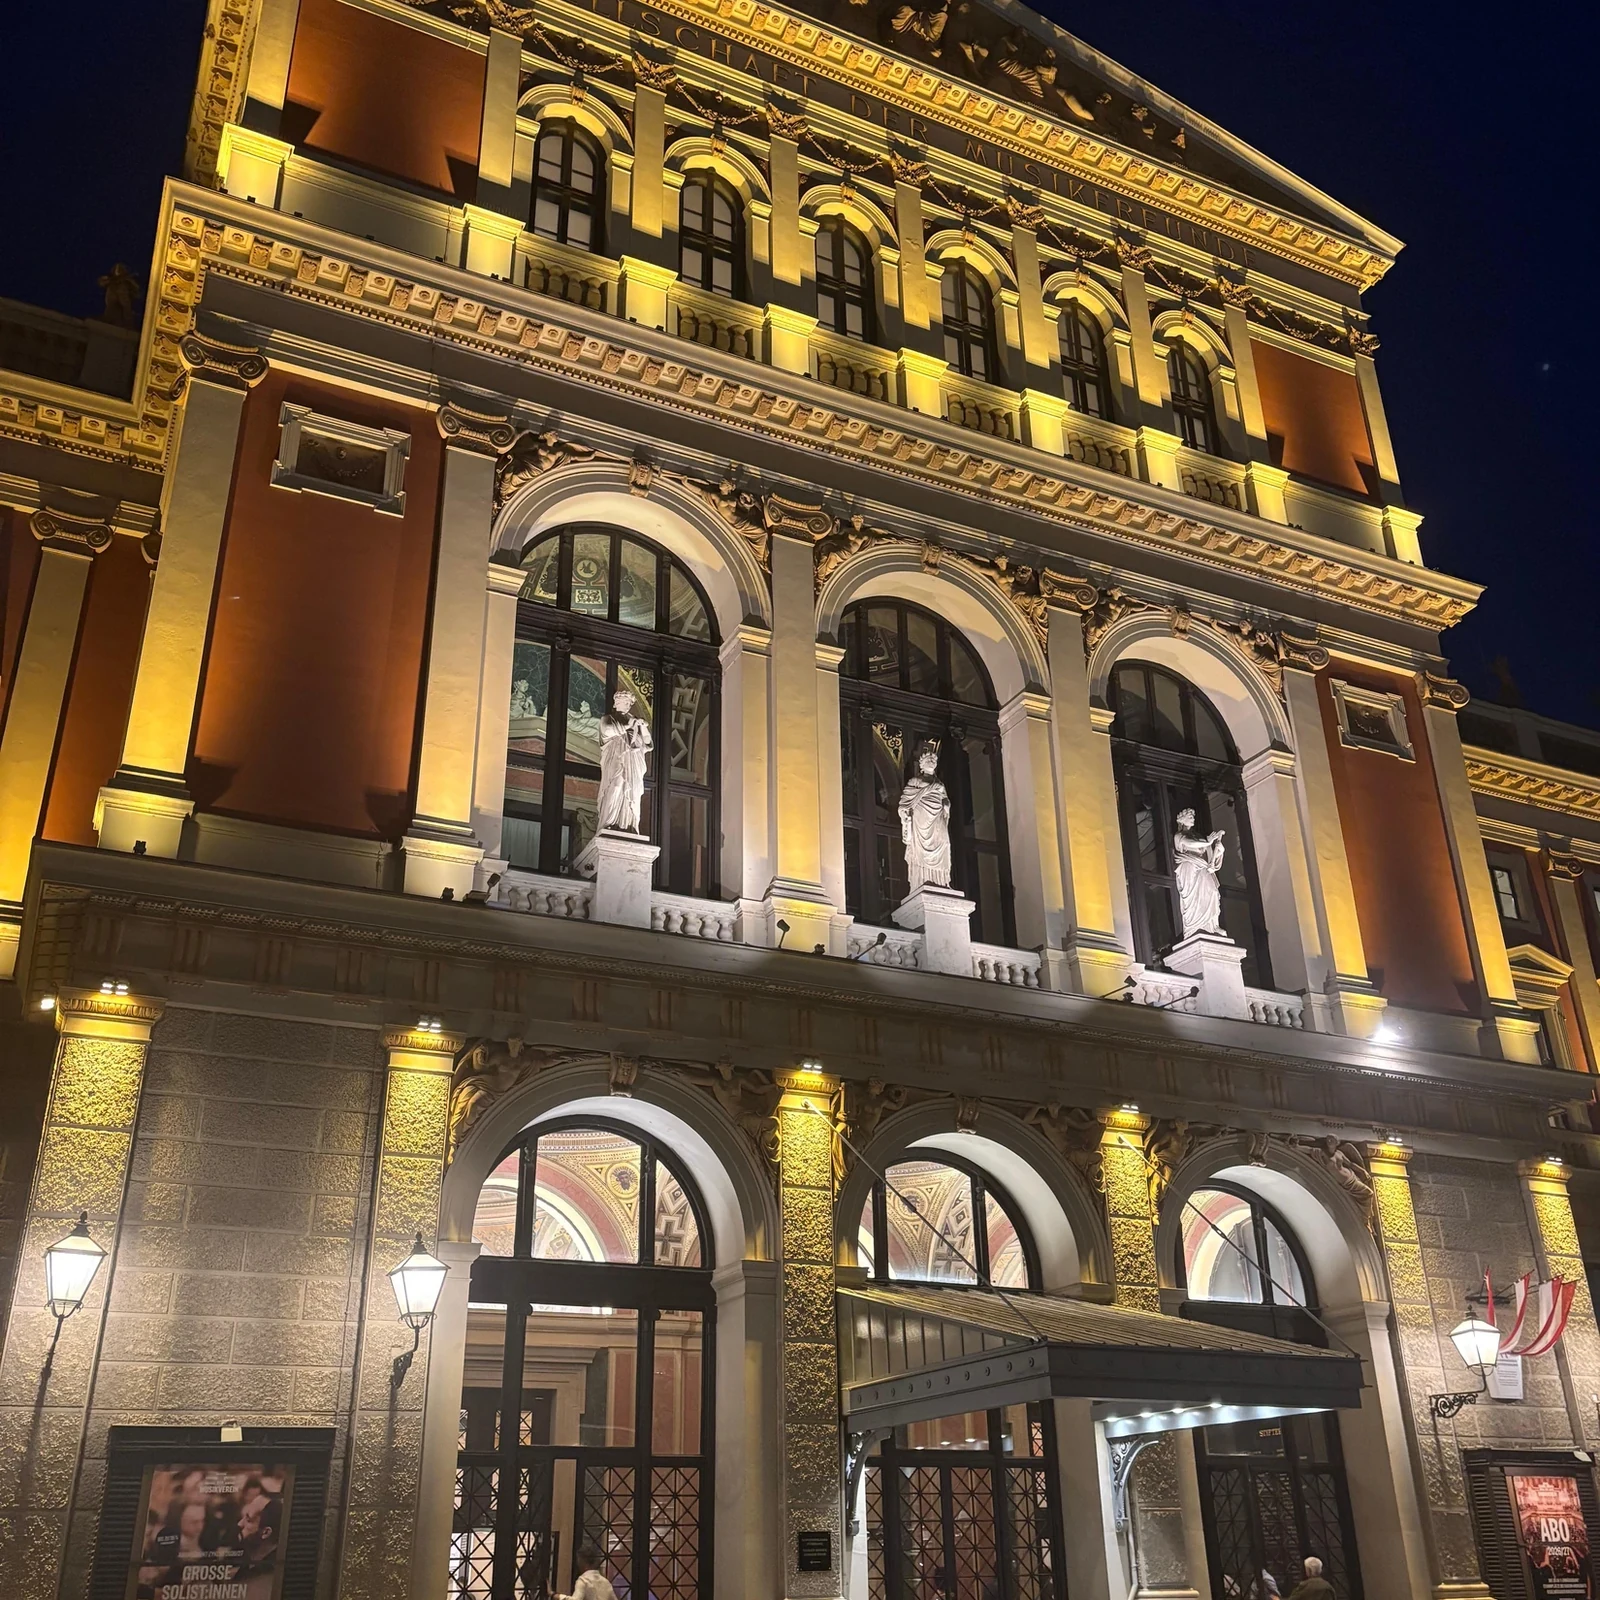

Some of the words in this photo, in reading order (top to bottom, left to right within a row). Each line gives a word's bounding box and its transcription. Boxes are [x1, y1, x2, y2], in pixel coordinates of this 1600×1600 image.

[850, 95, 930, 142] DER
[964, 139, 1257, 269] MUSIKFREUNDE
[1540, 1517, 1570, 1543] ABO
[182, 1564, 234, 1581] GROSSE
[161, 1583, 248, 1600] SOLIST:INNEN
